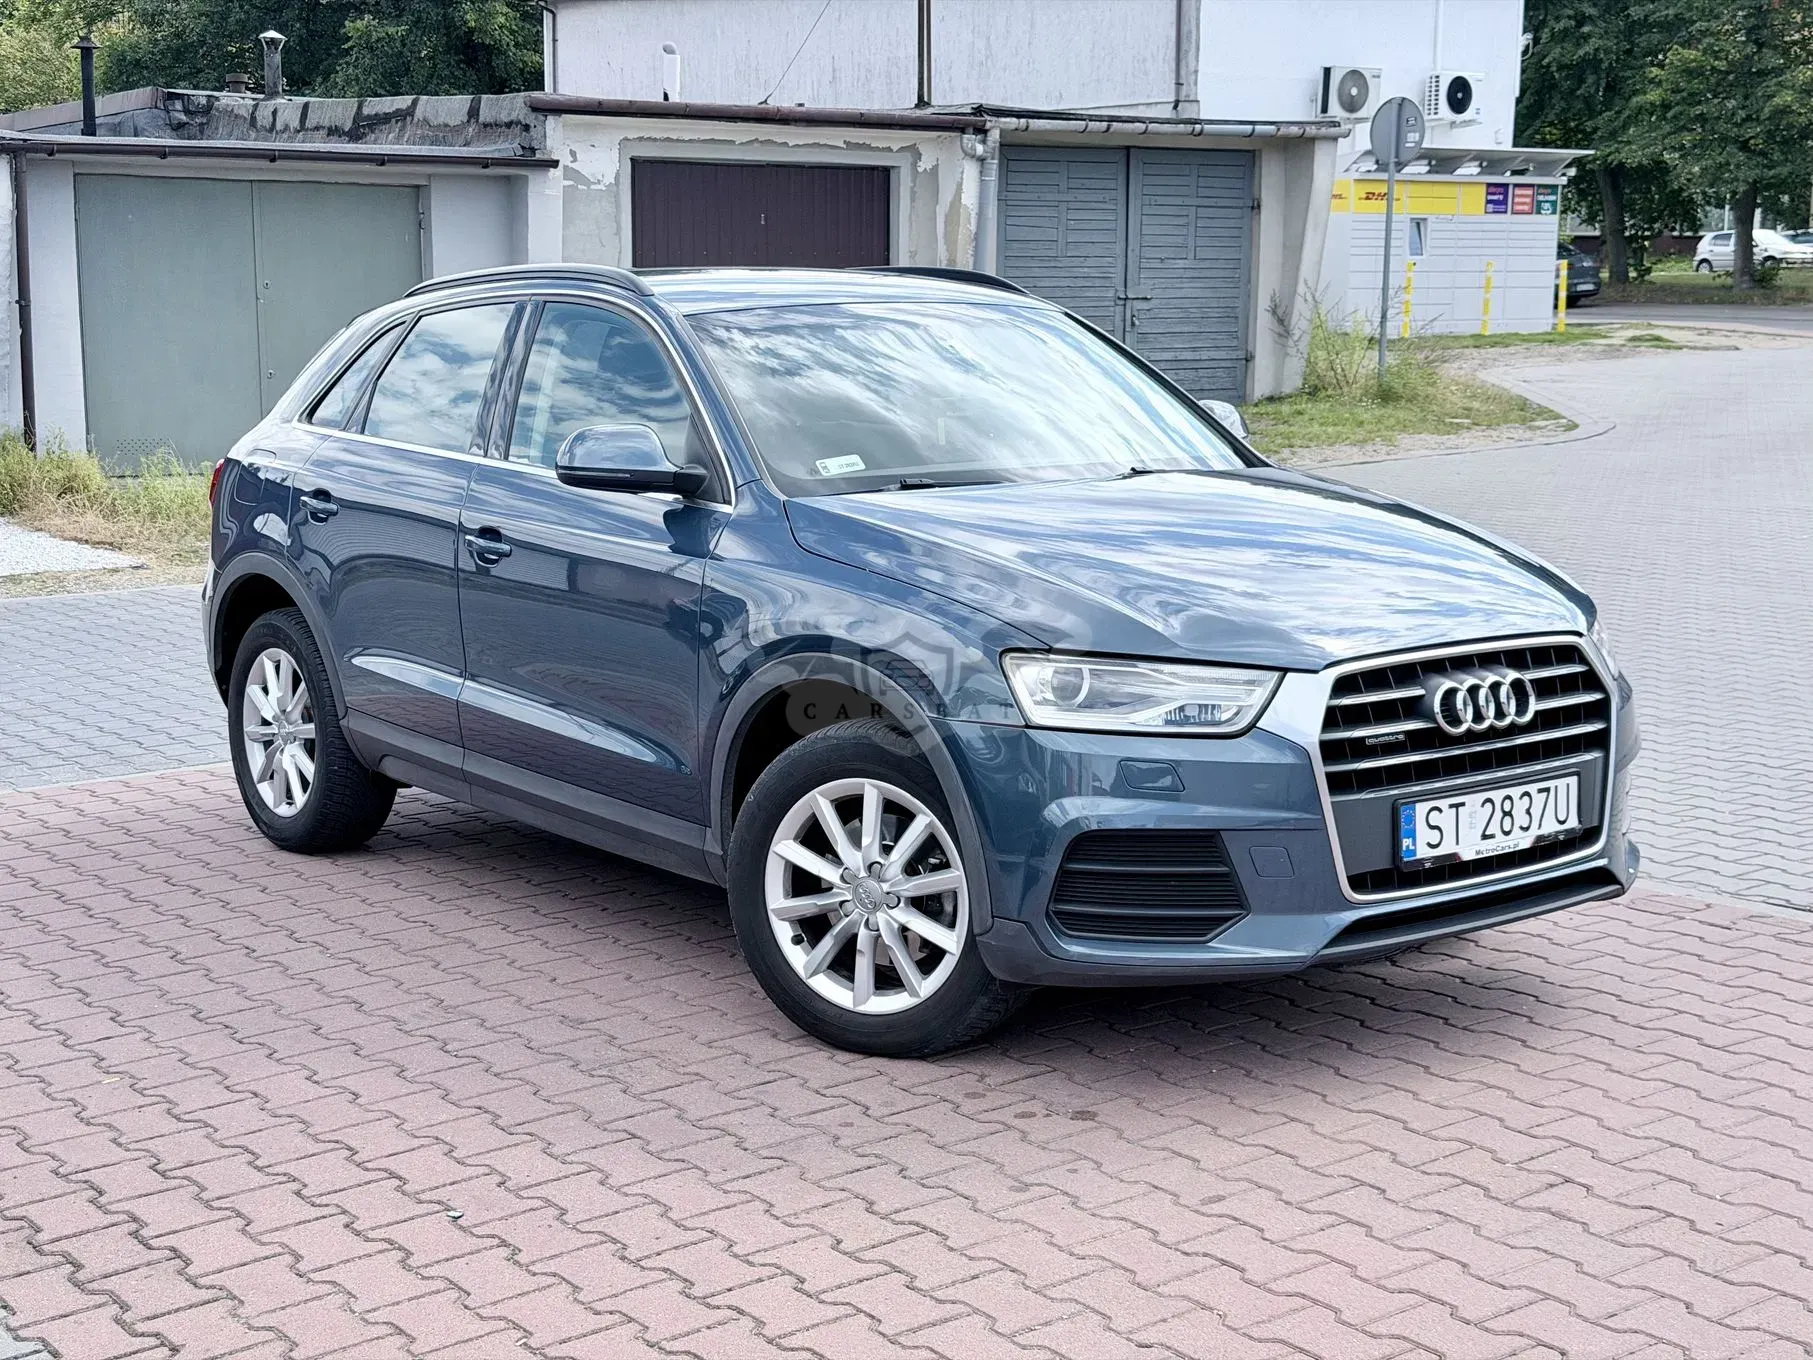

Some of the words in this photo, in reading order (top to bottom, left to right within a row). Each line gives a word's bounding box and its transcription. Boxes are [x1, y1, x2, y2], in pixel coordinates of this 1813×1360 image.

[1368, 734, 1404, 745] quattro
[1425, 801, 1466, 850] ST
[1480, 782, 1570, 841] 2837U
[1402, 838, 1416, 851] PL
[1474, 841, 1521, 857] MetroCars.pl
